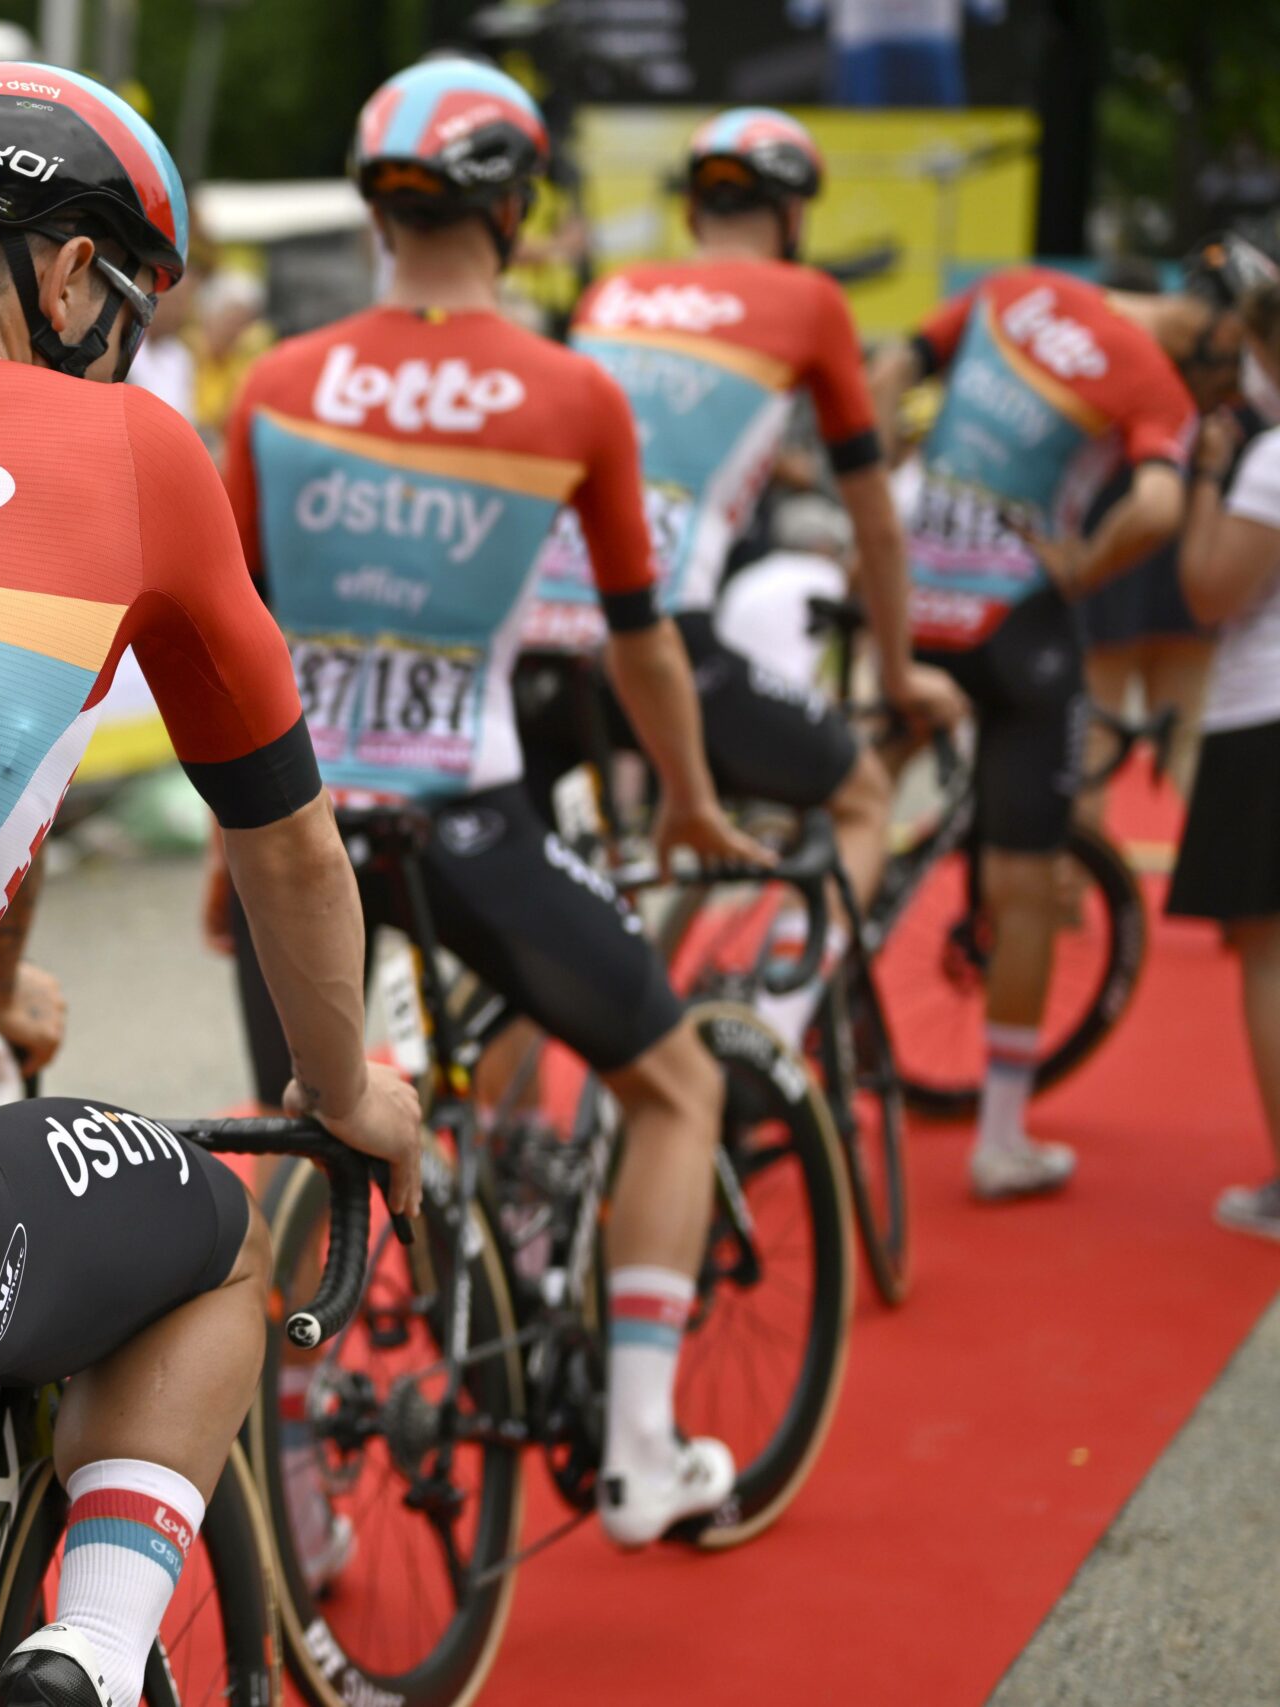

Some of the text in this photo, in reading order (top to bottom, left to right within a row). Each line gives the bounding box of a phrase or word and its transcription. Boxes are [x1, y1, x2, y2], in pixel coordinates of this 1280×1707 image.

[6, 80, 61, 98] dstny
[296, 468, 504, 562] dstny
[372, 653, 476, 732] 187
[44, 1105, 190, 1198] dstny
